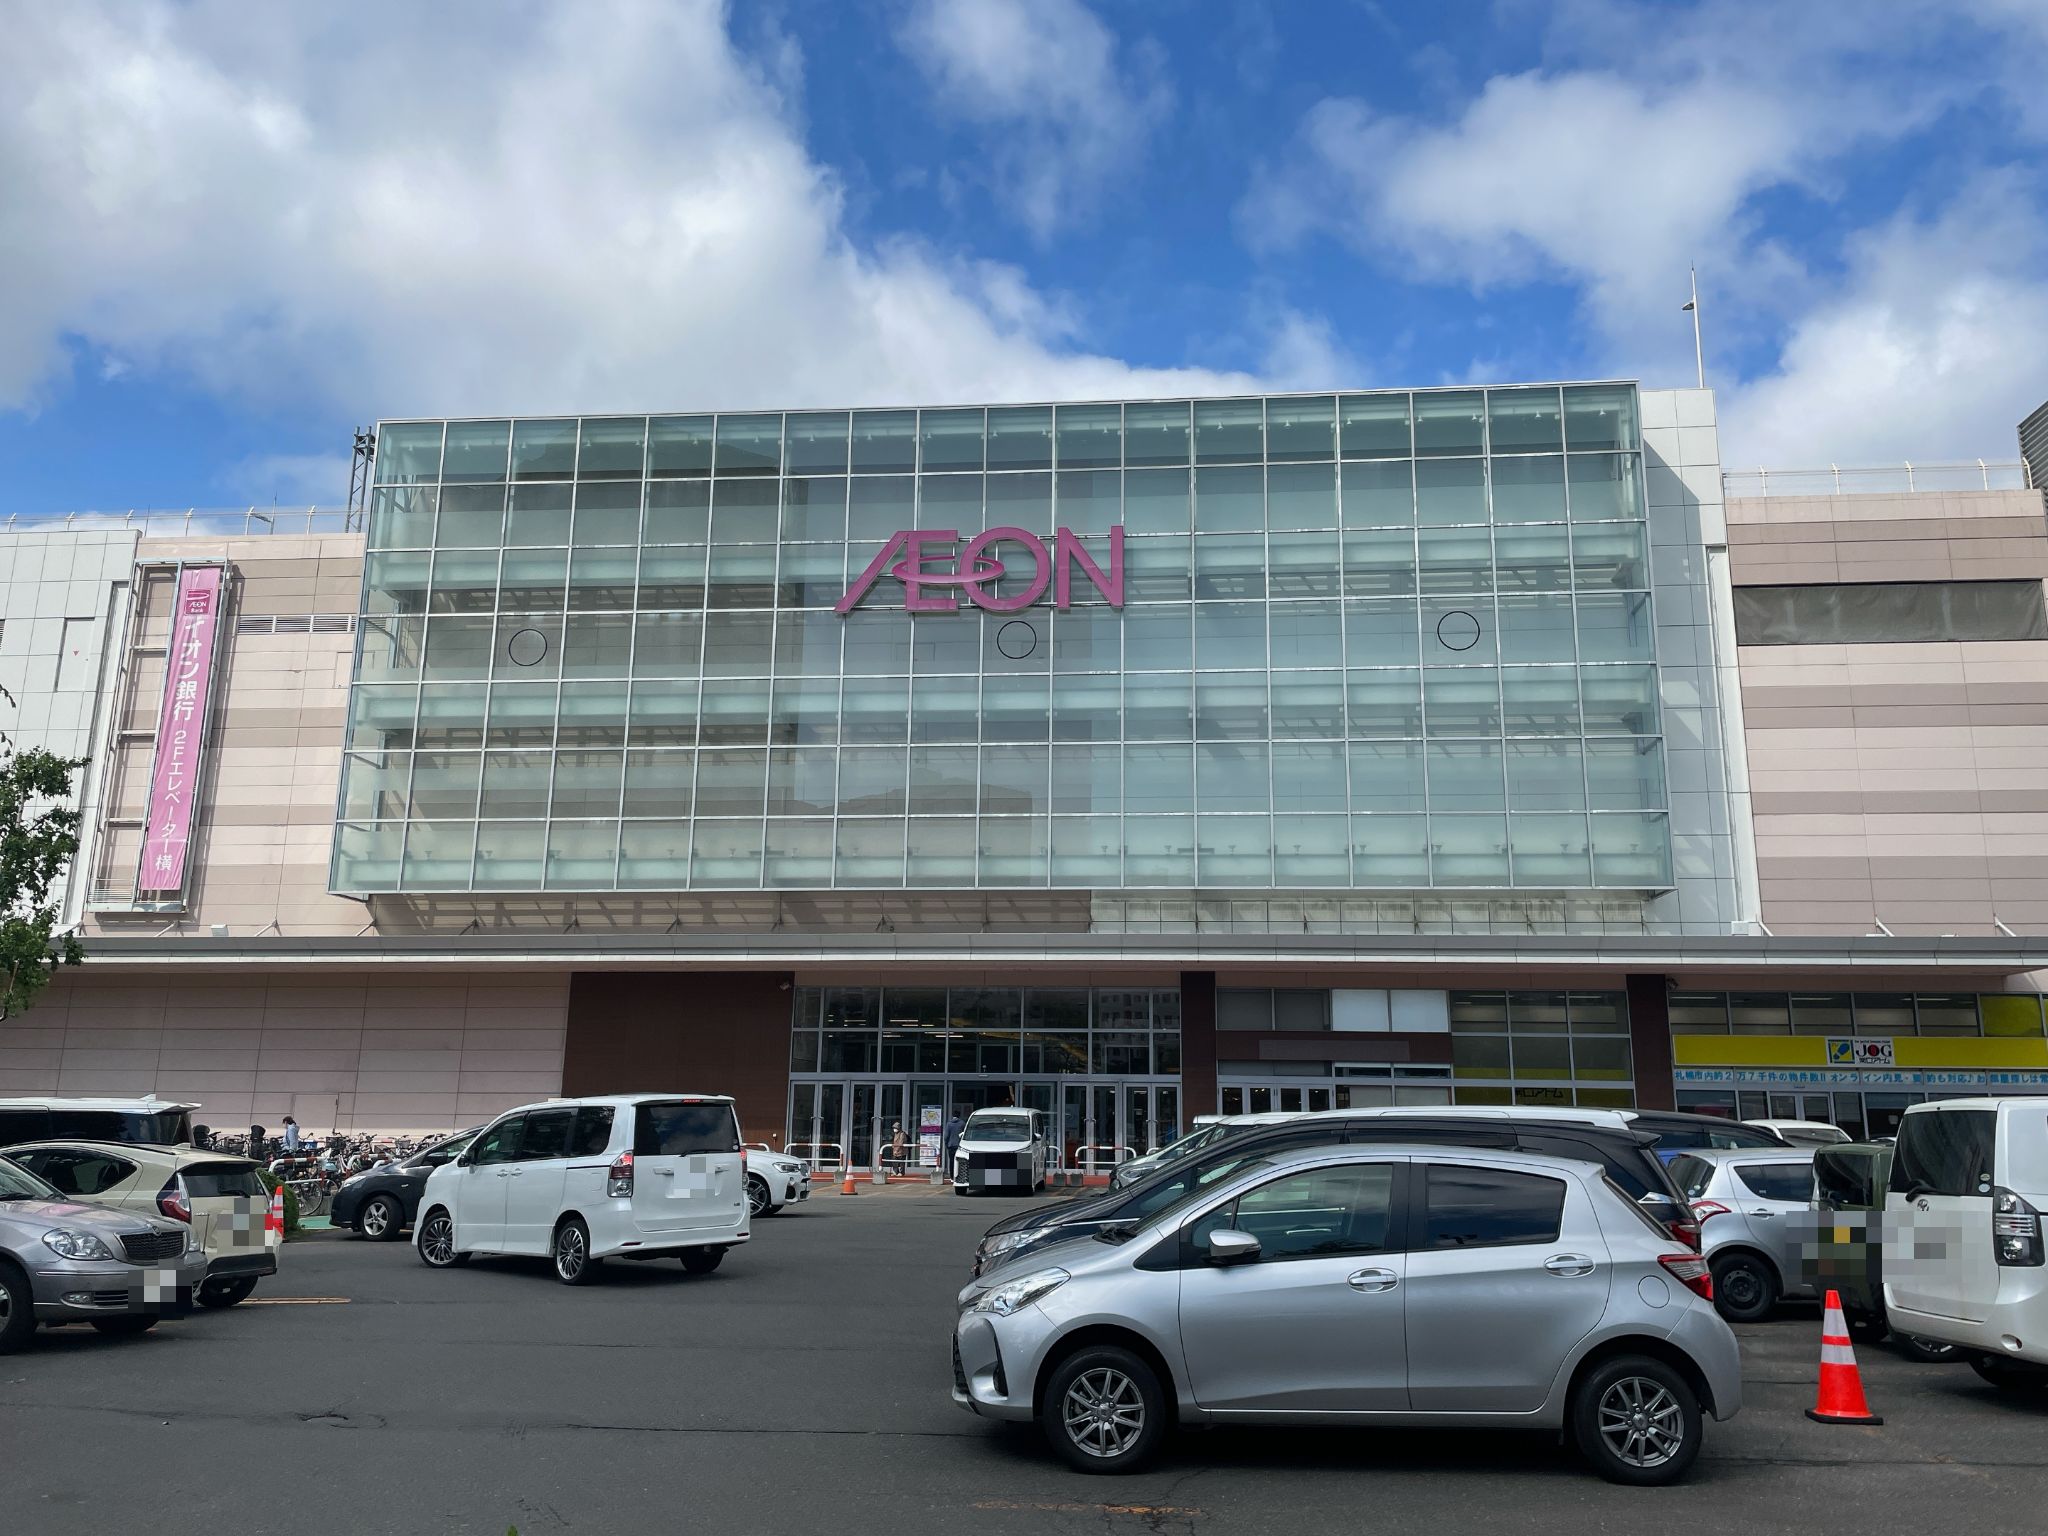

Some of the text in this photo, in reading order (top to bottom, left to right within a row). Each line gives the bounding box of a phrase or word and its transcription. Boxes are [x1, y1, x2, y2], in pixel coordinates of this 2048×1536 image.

[155, 616, 205, 871] イオン銀行 2Fエレベーター横
[1855, 1043, 1892, 1057] JOG
